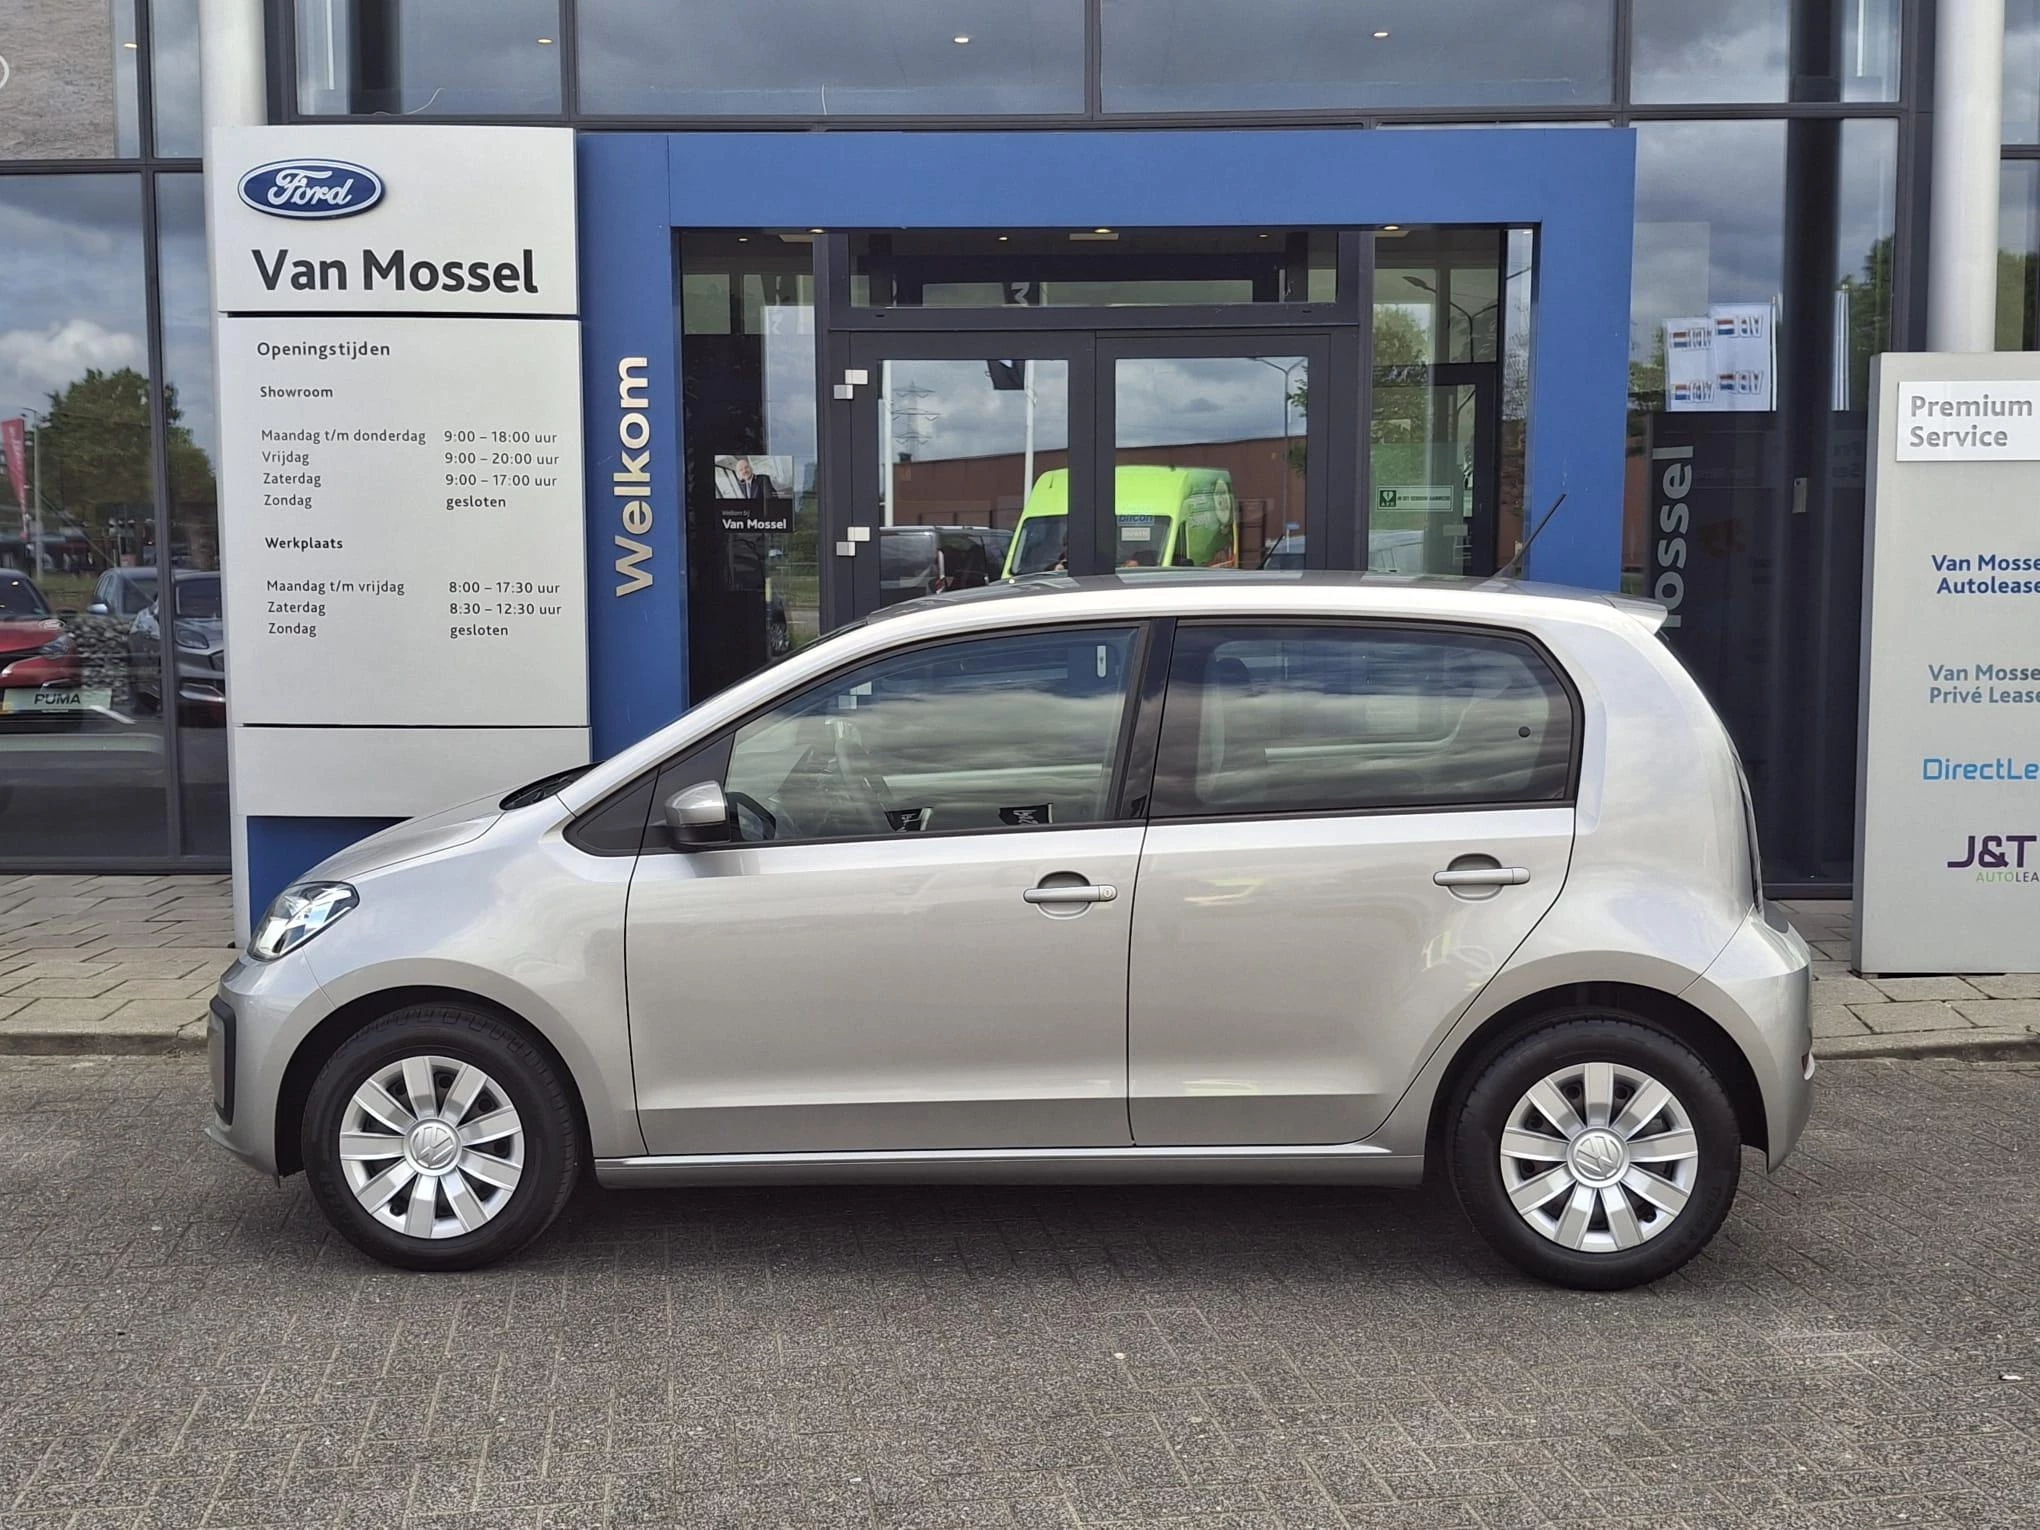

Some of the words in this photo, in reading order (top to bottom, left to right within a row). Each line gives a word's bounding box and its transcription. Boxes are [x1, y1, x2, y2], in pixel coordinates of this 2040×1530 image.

[267, 168, 351, 205] Ford
[252, 249, 347, 290] Van
[363, 249, 538, 293] Mossel
[257, 341, 389, 360] Openingstijden
[261, 386, 333, 397] Showroom
[1912, 394, 2032, 417] Premium
[262, 429, 320, 444] Maandag
[325, 429, 349, 441] t/m
[354, 429, 426, 445] donderdag
[445, 431, 475, 442] 9:00
[492, 431, 529, 443] 18:00
[535, 435, 557, 443] uur
[1910, 425, 2008, 447] Service
[262, 451, 309, 466] Vrijdag
[445, 452, 475, 464] 9:00
[492, 453, 531, 464] 20:00
[264, 472, 321, 487] Zaterdag
[446, 474, 476, 485] 9:00
[493, 475, 529, 486] 17:00
[535, 478, 557, 486] uur
[612, 356, 653, 597] Welkom
[264, 494, 312, 509] Zondag
[447, 495, 505, 510] gesloten
[723, 519, 744, 528] Van
[747, 519, 786, 529] Mossel
[265, 537, 343, 552] Werkplaats
[1652, 446, 1694, 628] ossel
[1932, 555, 1970, 571] Van
[267, 580, 325, 595] Maandag
[330, 580, 353, 592] t/m
[359, 580, 404, 595] vrijdag
[449, 582, 479, 593] 8:00
[496, 582, 532, 593] 17:30
[538, 585, 560, 593] uur
[268, 601, 326, 616] Zaterdag
[450, 603, 480, 614] 8:30
[497, 604, 534, 614] 12:30
[269, 622, 316, 637] Zondag
[450, 624, 508, 639] gesloten
[1928, 665, 1968, 681] Van
[33, 693, 81, 705] PUMA
[1930, 686, 1982, 703] Privé
[1947, 835, 2037, 868] J&T
